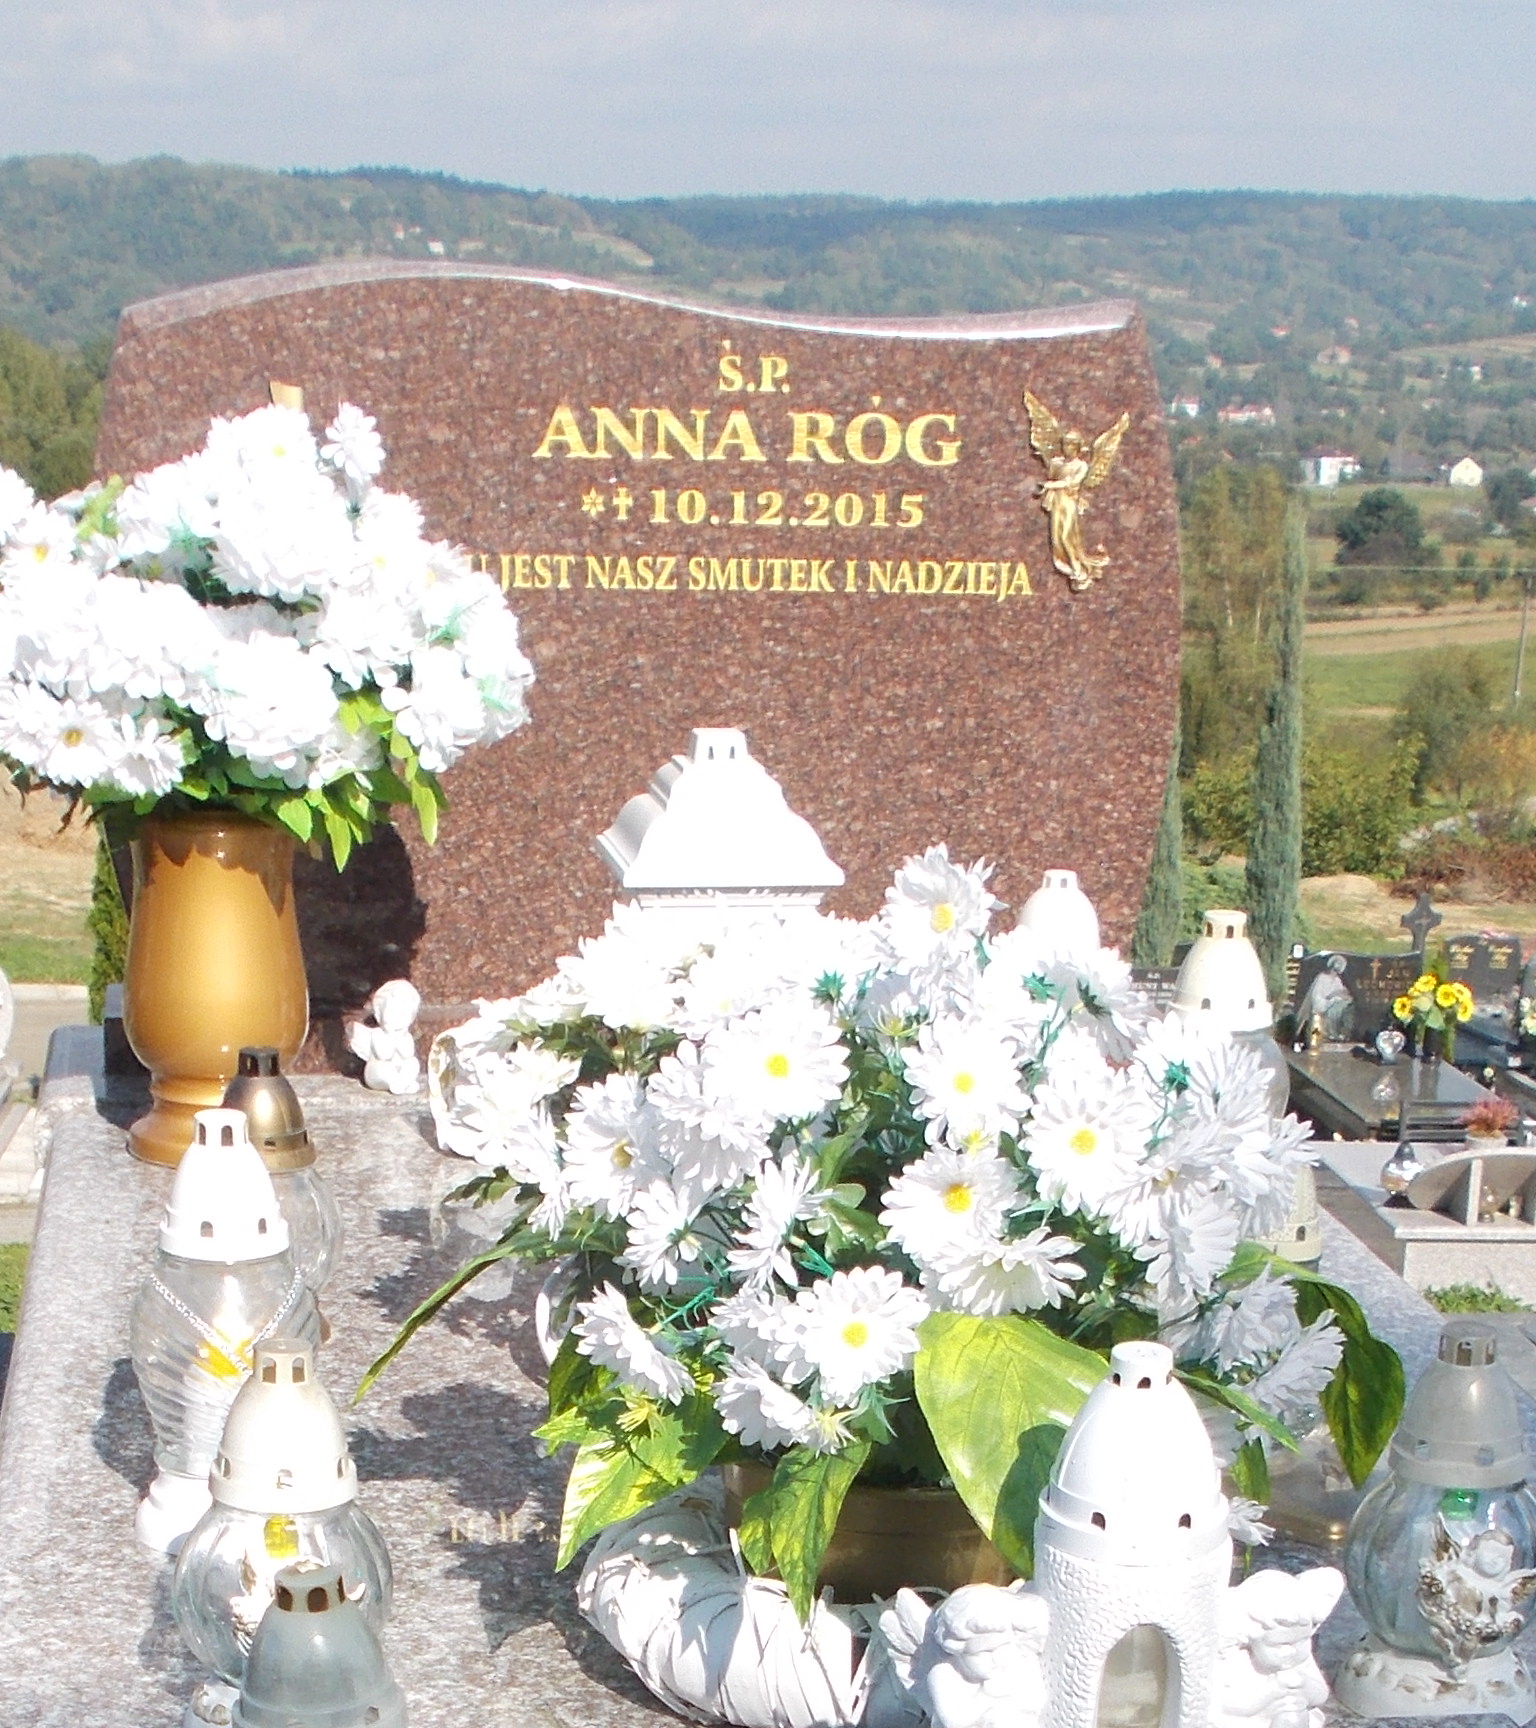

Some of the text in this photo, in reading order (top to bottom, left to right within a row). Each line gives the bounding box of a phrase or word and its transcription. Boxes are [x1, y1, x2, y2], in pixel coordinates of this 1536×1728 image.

[531, 394, 963, 467] ANNA RÓG
[649, 487, 926, 529] 10.12.2015
[584, 554, 678, 591] NASZ
[687, 556, 837, 594] SMUTEK
[843, 558, 860, 593] I
[865, 558, 1035, 602] NADZIEJA
